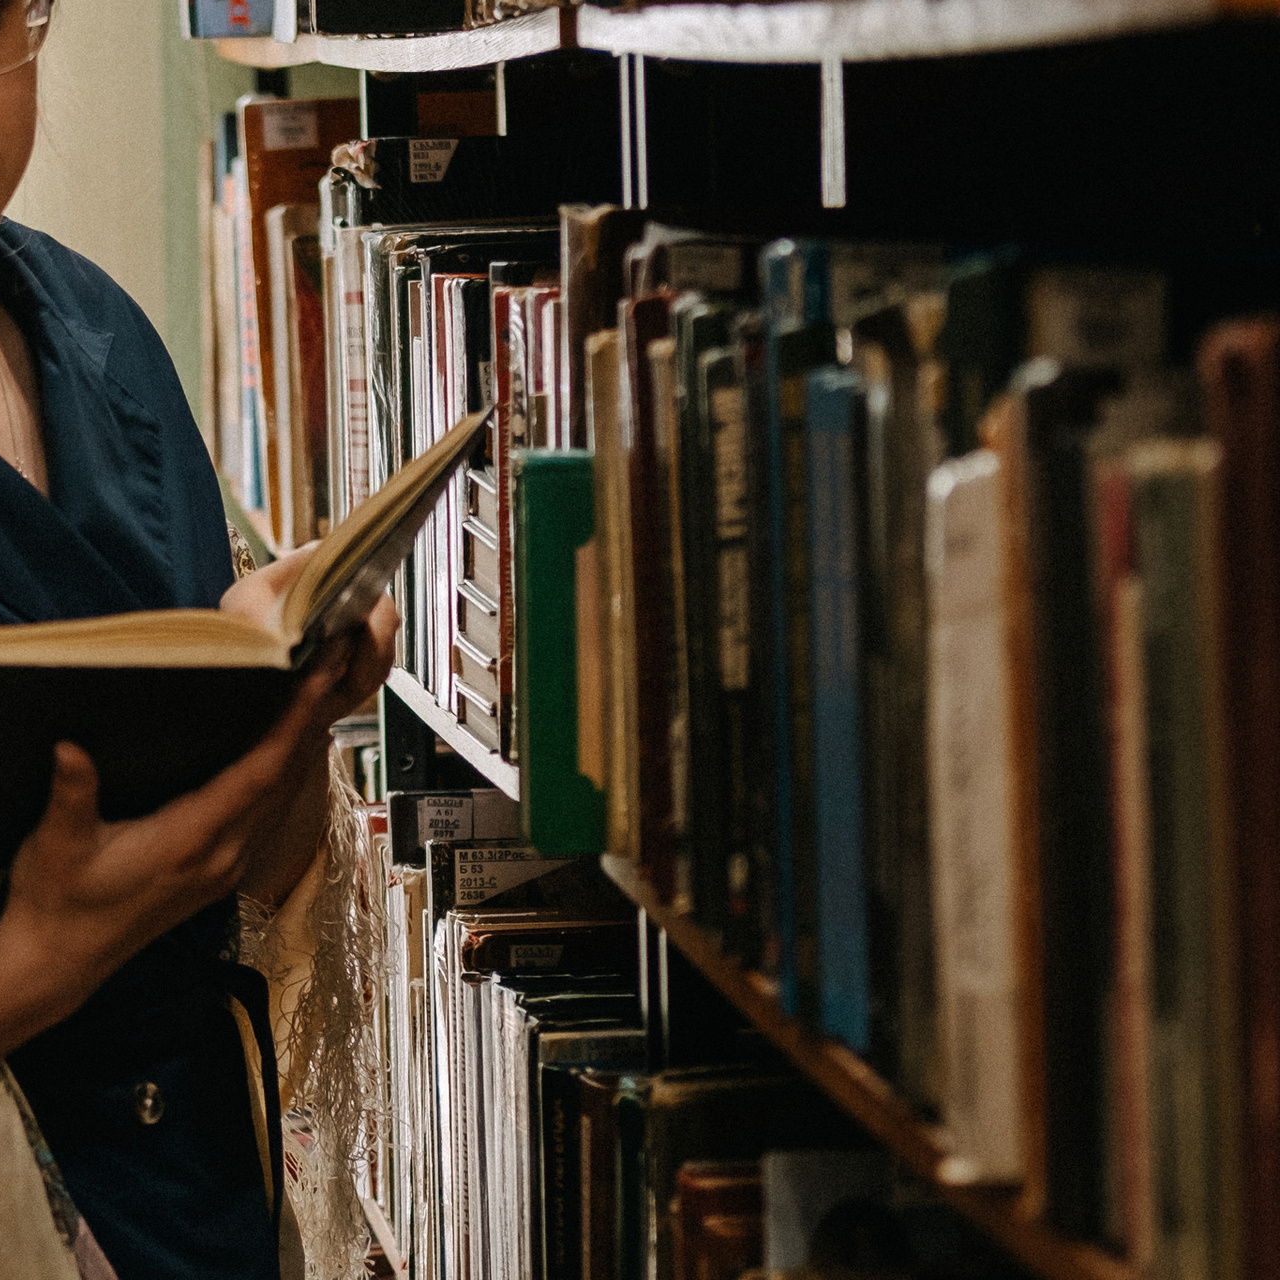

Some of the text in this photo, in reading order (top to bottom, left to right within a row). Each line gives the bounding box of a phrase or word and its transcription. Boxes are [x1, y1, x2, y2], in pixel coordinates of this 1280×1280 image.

[459, 851, 469, 861] М
[460, 864, 483, 874] Б 53
[460, 877, 497, 887] 2013-С
[460, 891, 486, 900] 2636
